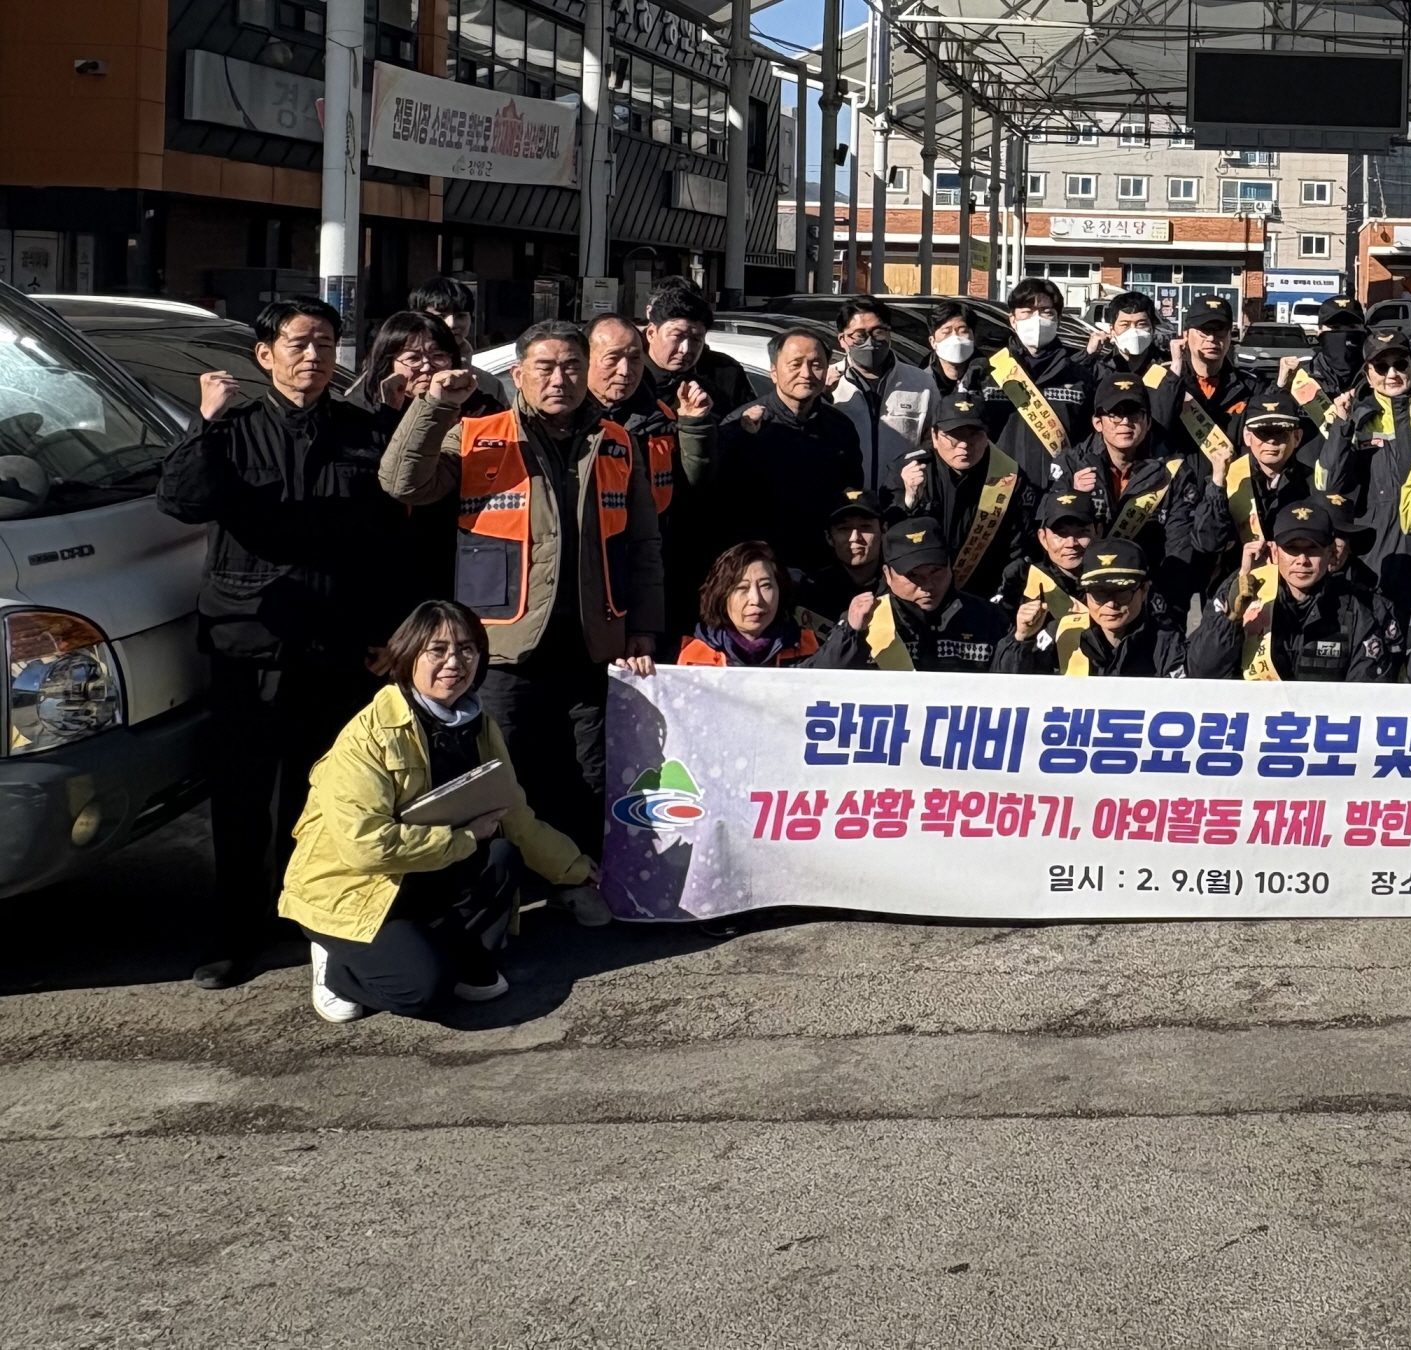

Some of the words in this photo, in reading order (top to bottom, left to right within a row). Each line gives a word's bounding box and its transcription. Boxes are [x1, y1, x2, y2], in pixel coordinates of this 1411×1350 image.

[805, 702, 909, 766] 한파
[919, 706, 1029, 772] 대비
[1039, 707, 1251, 776] 행동요령
[1258, 711, 1362, 778] 홍보
[749, 790, 829, 841] 기상
[835, 788, 915, 840] 상황
[920, 788, 1080, 841] 확인하기,
[1092, 797, 1243, 845] 야외활동
[1247, 800, 1331, 848] 자제,
[1049, 865, 1104, 892] 일시
[1136, 868, 1160, 891] 2.
[1172, 869, 1243, 896] 9.(월)
[1254, 871, 1330, 894] 10:30
